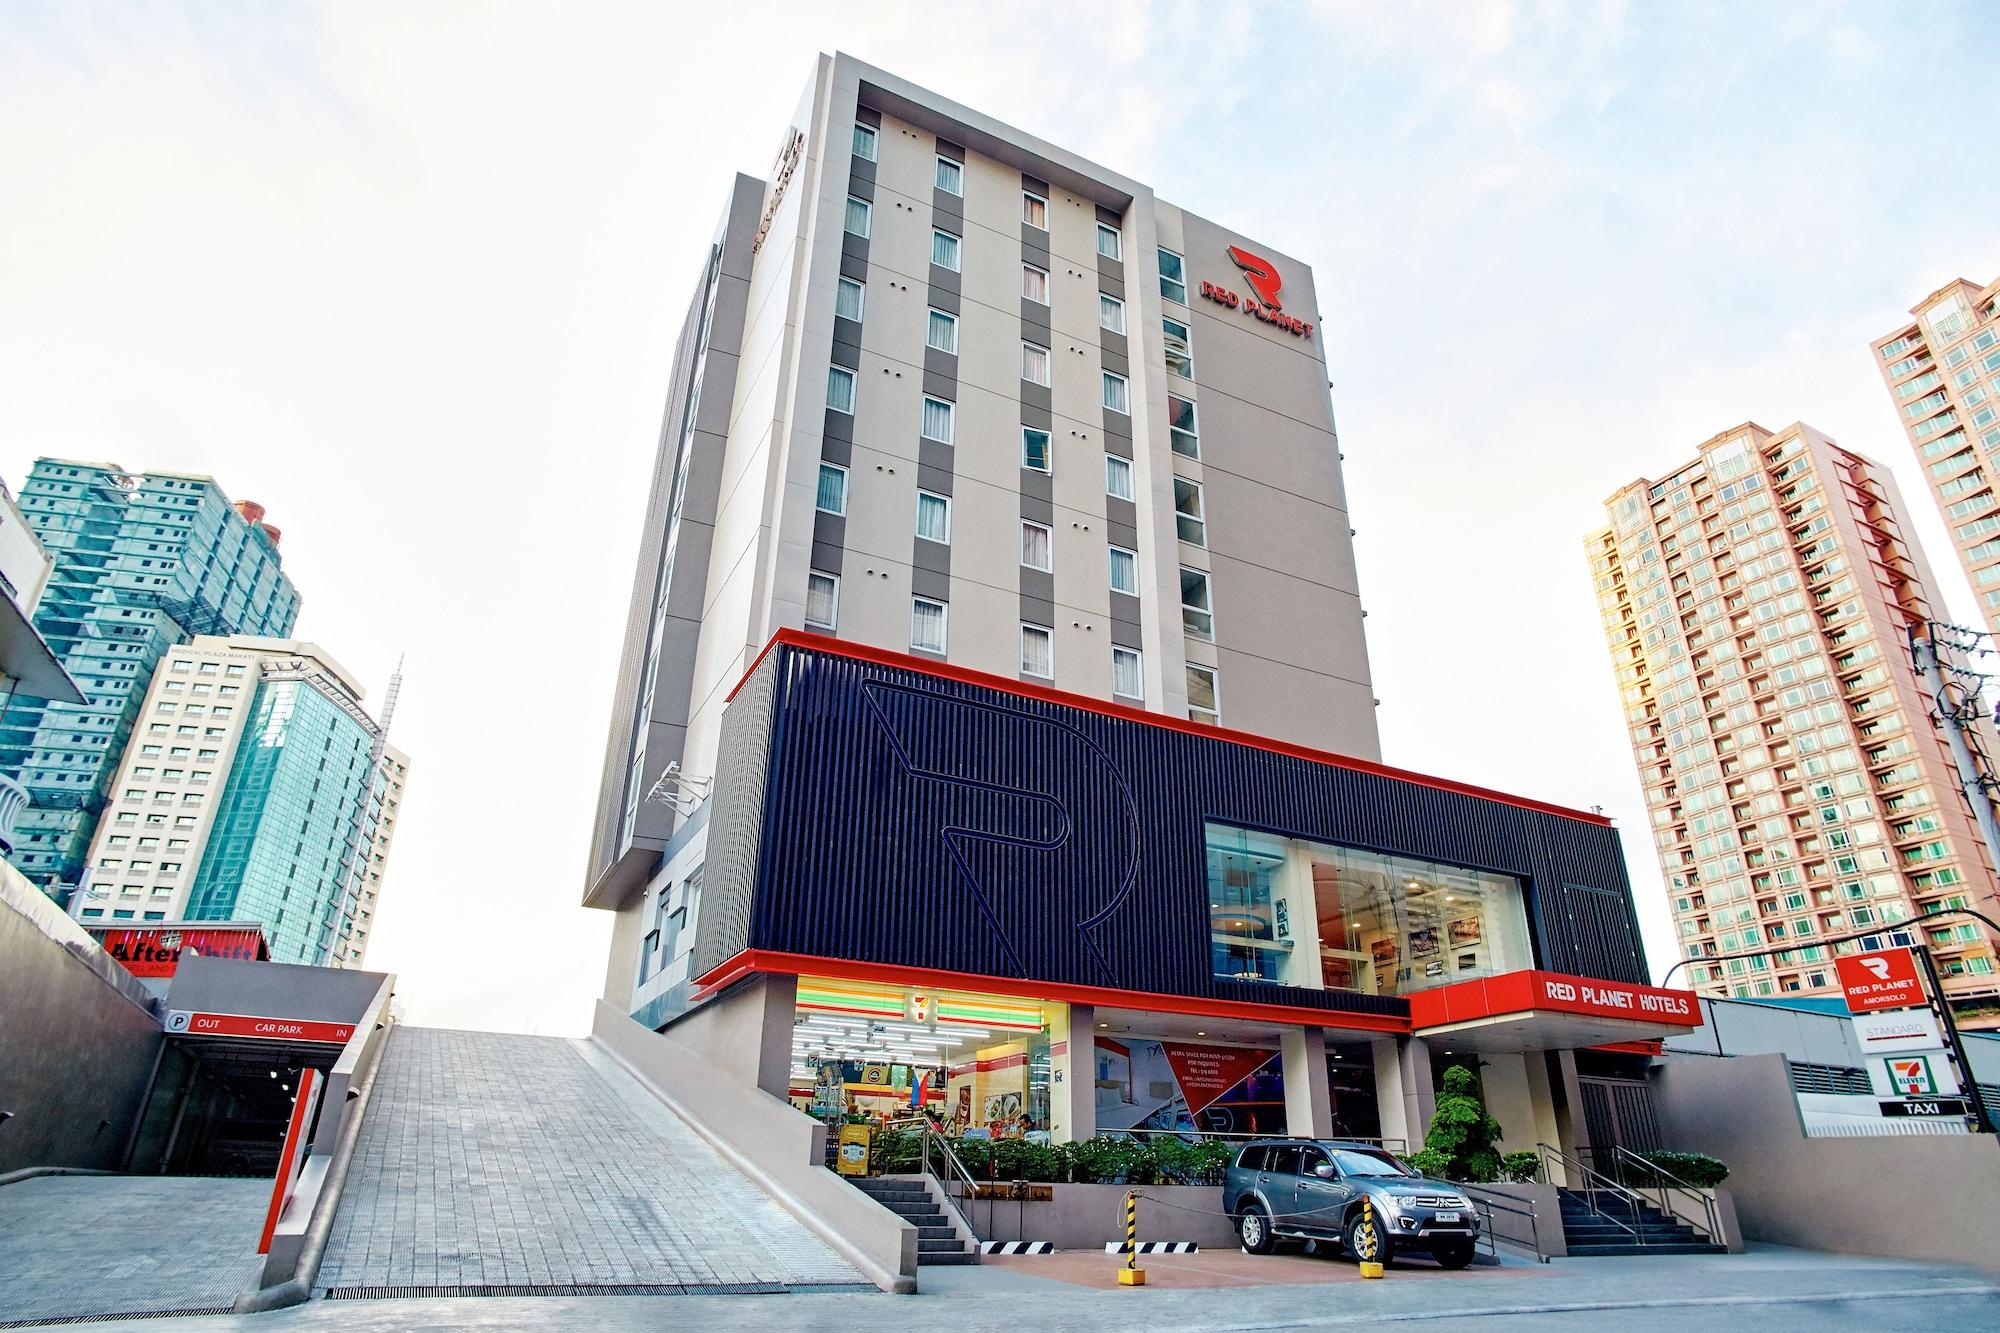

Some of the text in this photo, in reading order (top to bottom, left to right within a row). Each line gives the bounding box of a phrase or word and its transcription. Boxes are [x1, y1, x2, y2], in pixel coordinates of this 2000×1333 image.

[1201, 280, 1313, 338] RED PLANET
[1848, 979, 1915, 996] RED PLANET
[1545, 981, 1690, 1015] RED PLANET HOTELS
[1863, 993, 1907, 1005] AMORSOLO
[198, 1019, 221, 1029] OUT
[255, 1023, 276, 1033] CAR
[278, 1024, 303, 1034] PARK
[336, 1029, 347, 1038] IN
[1903, 1102, 1940, 1115] TAXI
